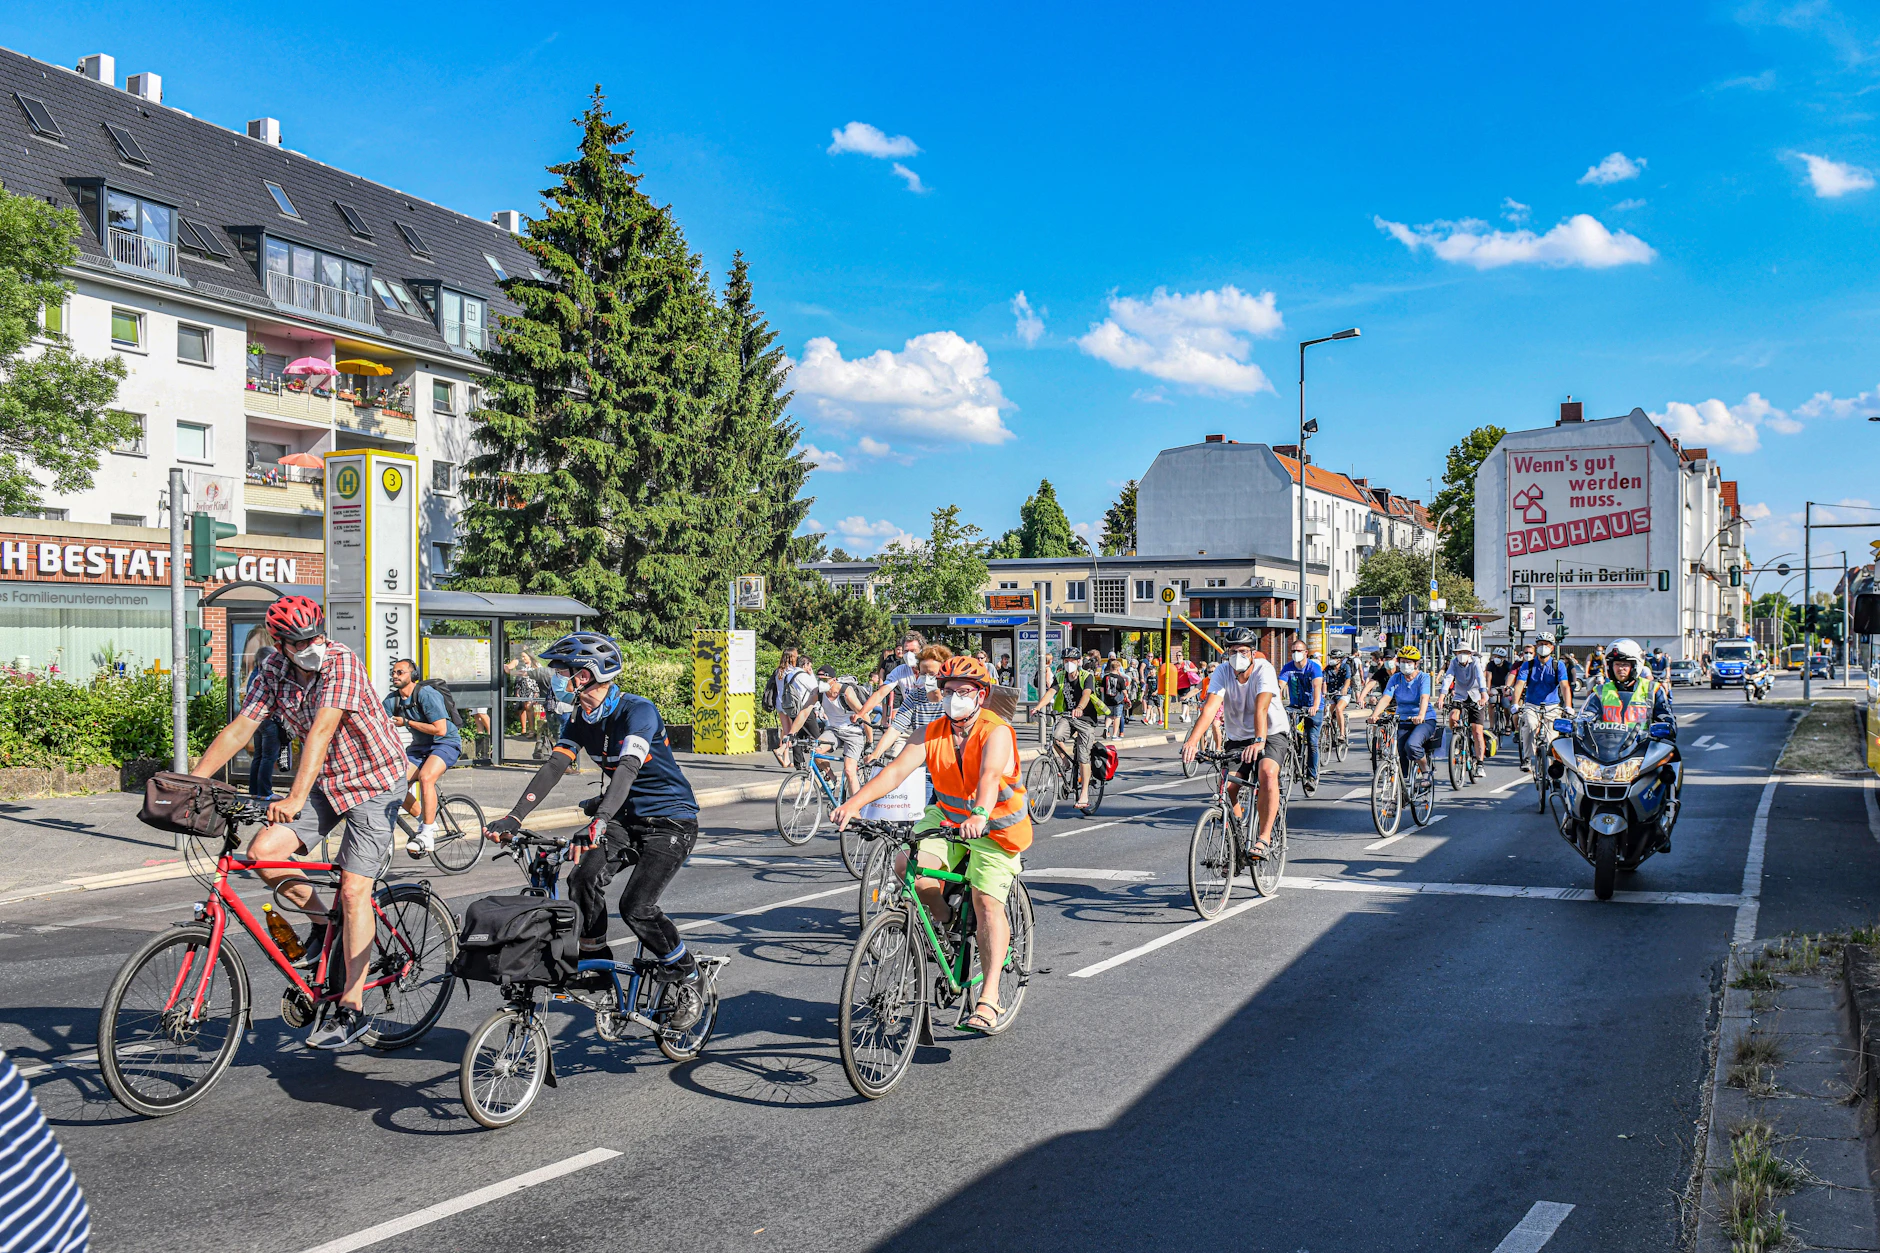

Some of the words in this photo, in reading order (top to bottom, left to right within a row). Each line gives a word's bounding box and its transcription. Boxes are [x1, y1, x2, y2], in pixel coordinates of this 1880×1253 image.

[1514, 455, 1578, 473] Wenn's
[1584, 455, 1615, 476] gut
[342, 473, 354, 492] H
[389, 473, 396, 487] 3
[1568, 471, 1642, 491] werden
[1570, 494, 1622, 508] muss.
[1509, 509, 1650, 553] BAUHAUS
[1512, 569, 1574, 584] Führend
[1579, 569, 1593, 583] in
[1599, 567, 1645, 583] Berlin
[12, 590, 149, 606] Familienunternehmen
[974, 617, 1009, 625] Alt-Mariendorf
[1593, 722, 1629, 732] POLIZEI
